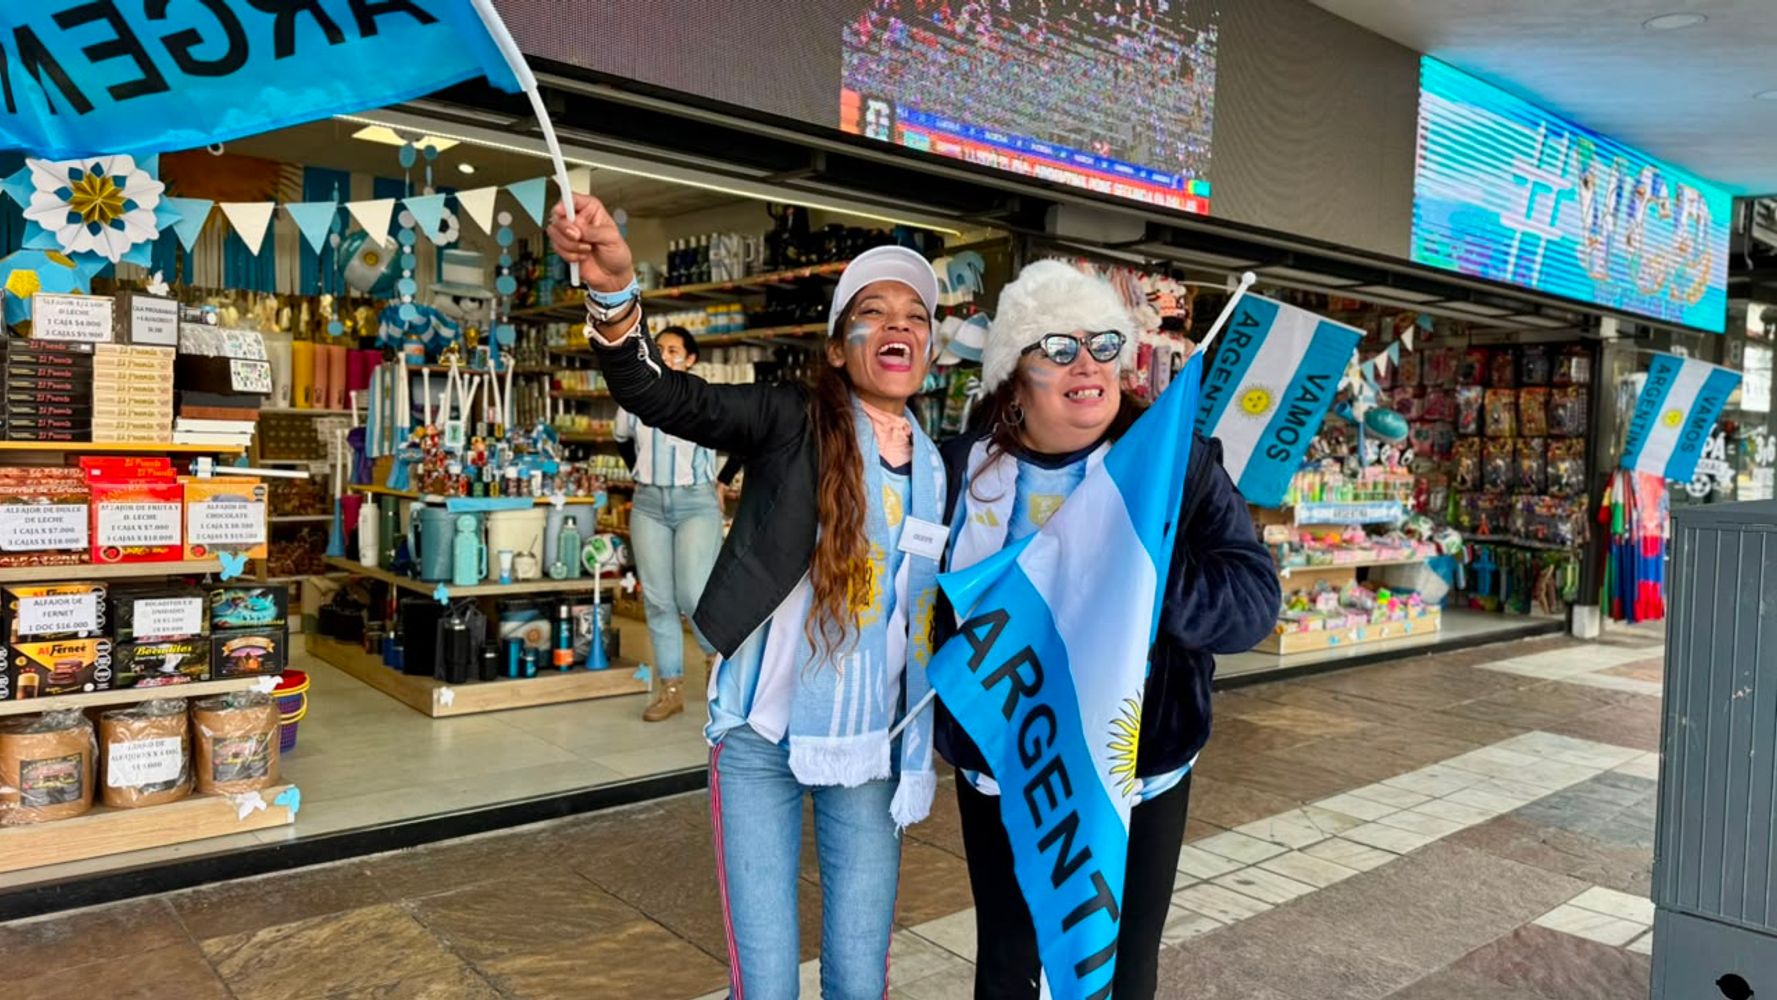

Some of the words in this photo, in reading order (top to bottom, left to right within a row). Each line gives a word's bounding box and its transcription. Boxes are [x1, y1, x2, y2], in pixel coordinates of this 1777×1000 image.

[1192, 310, 1260, 434] ARGENTI
[1266, 374, 1331, 462] VAMOS
[1624, 363, 1671, 456] ARGENTINA
[1681, 396, 1719, 453] VAMOS
[33, 598, 71, 607] ALFAJOR
[35, 623, 54, 631] DOC
[42, 610, 74, 618] FERNET
